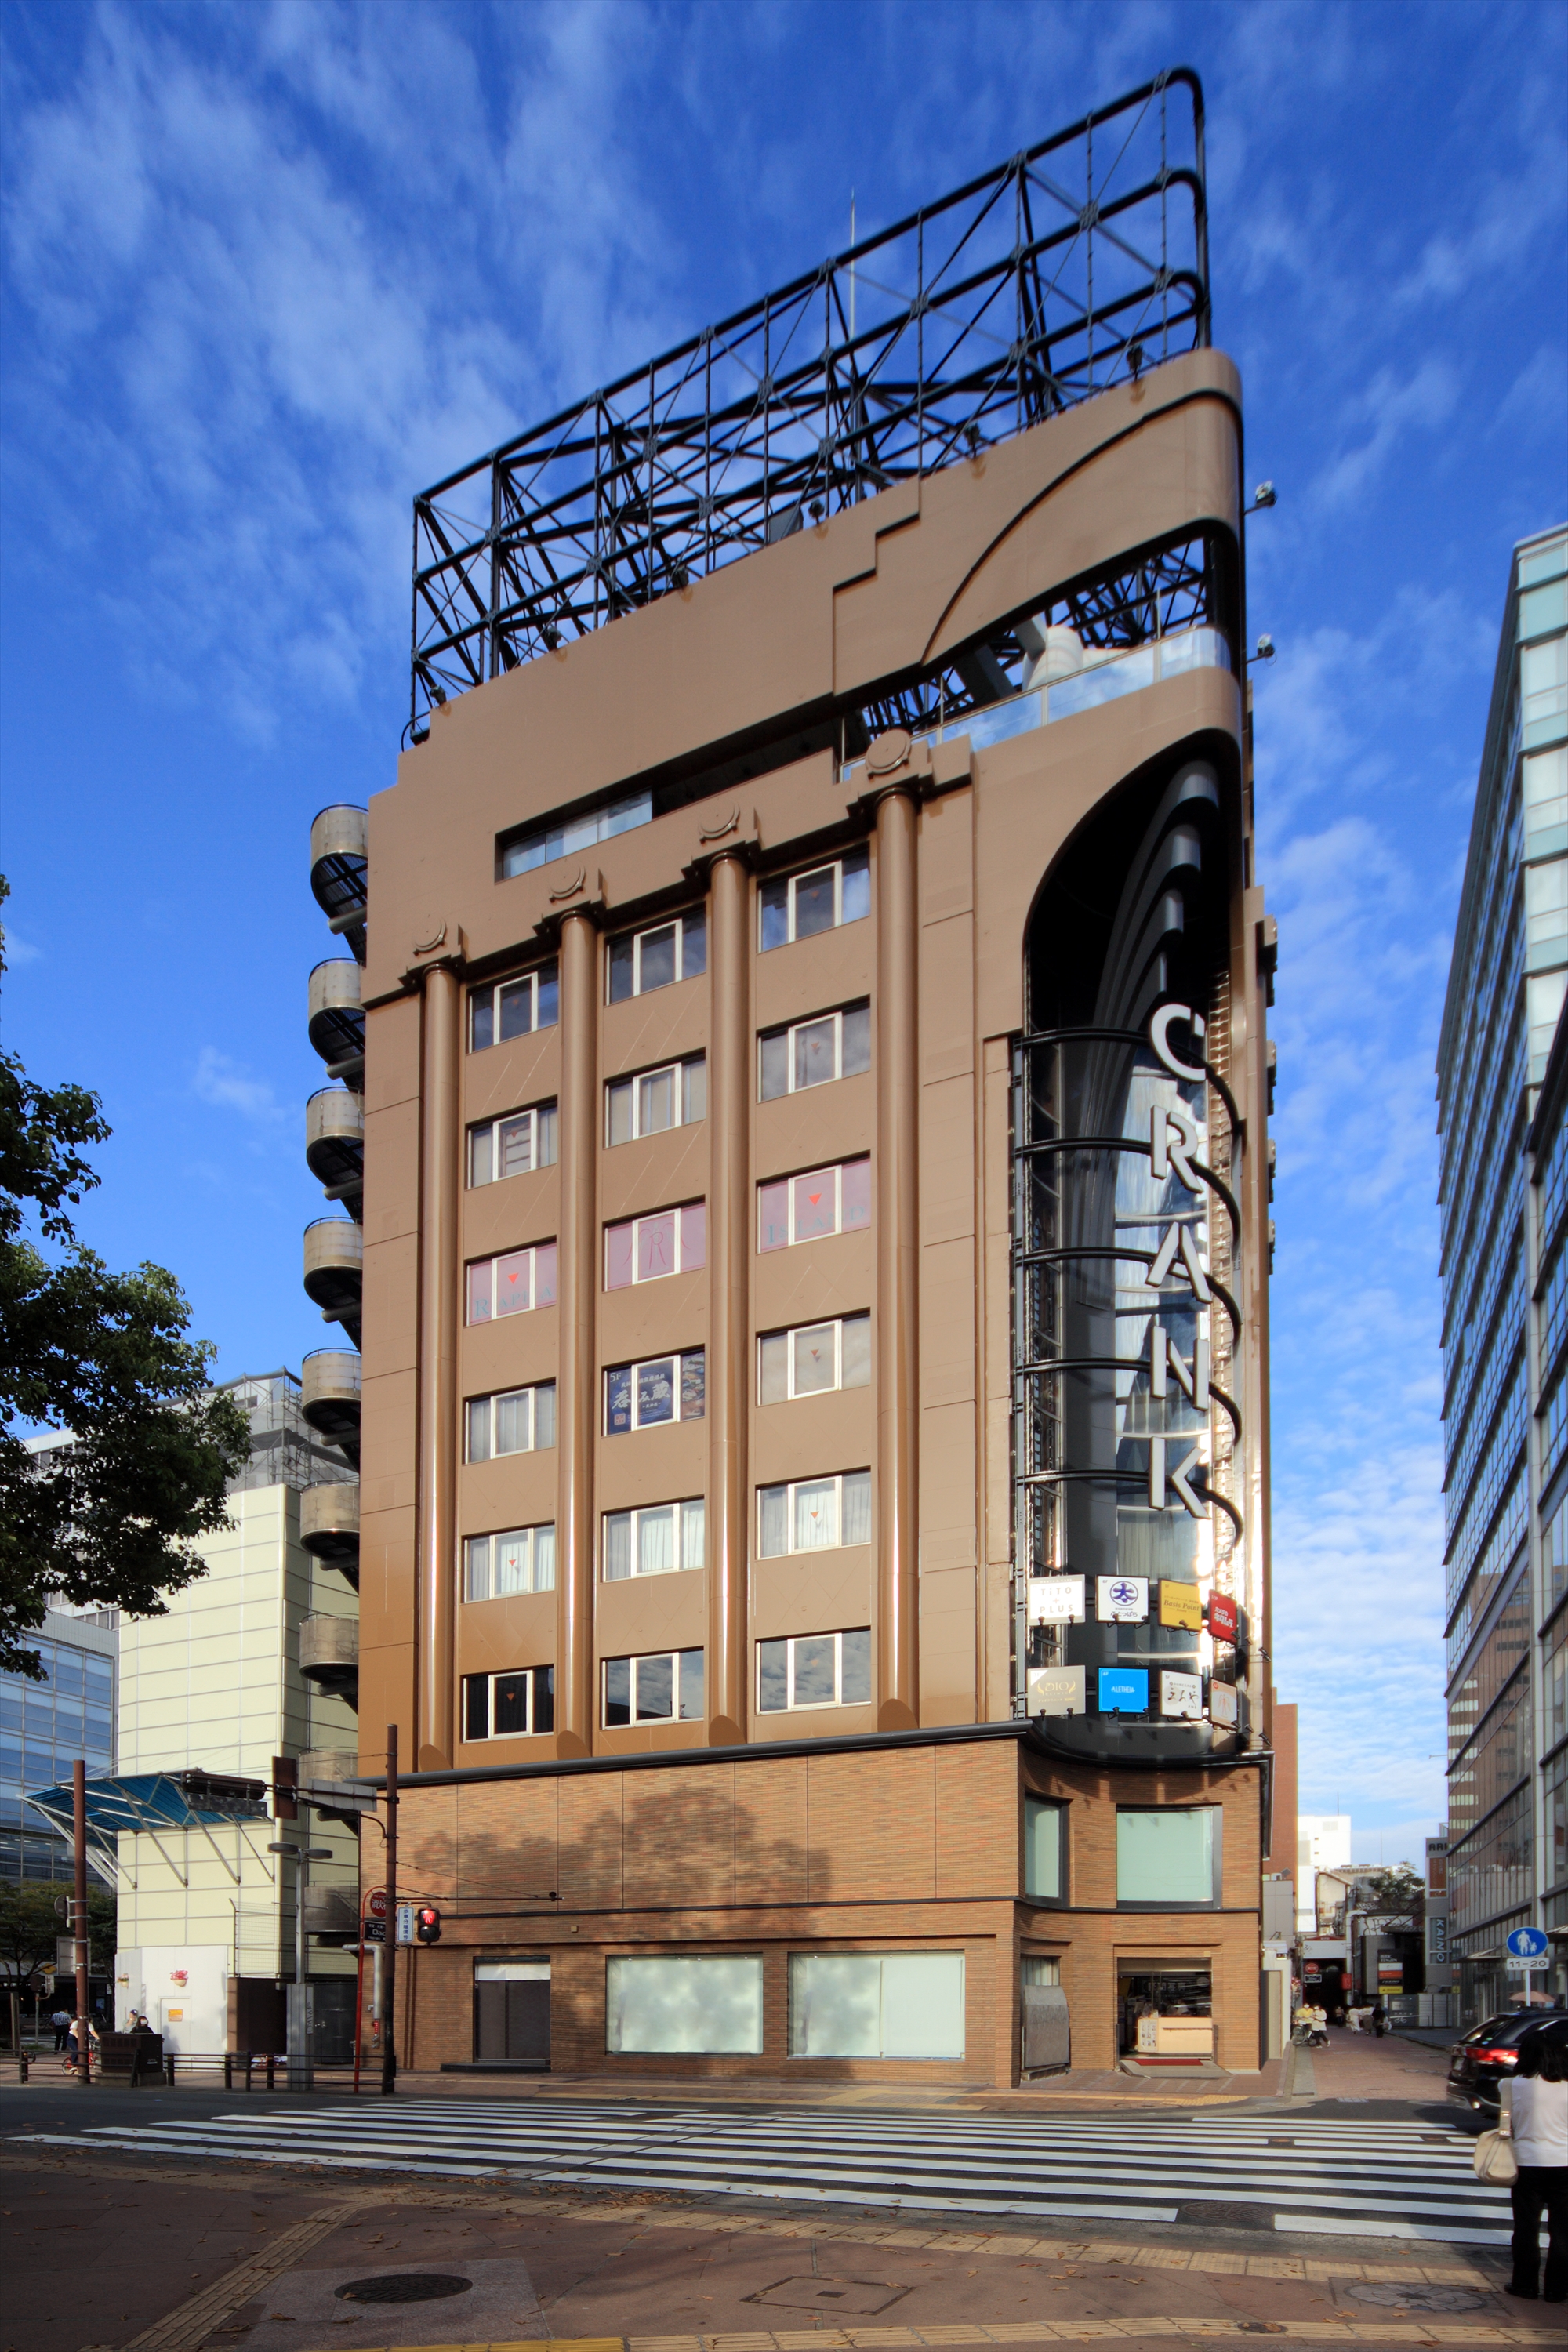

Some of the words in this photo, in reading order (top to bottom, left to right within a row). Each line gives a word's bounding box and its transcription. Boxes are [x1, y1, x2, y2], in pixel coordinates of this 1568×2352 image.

[1145, 1003, 1212, 1519] CRANK
[474, 1286, 553, 1317] RAPIA
[610, 1372, 622, 1382] 5F
[1040, 1586, 1073, 1596] TiTO
[1040, 1604, 1073, 1614] PLUS
[1163, 1599, 1181, 1608] Basis
[1182, 1602, 1200, 1612] Point
[1045, 1682, 1069, 1691] DIO
[1436, 1918, 1445, 1962] KAINO
